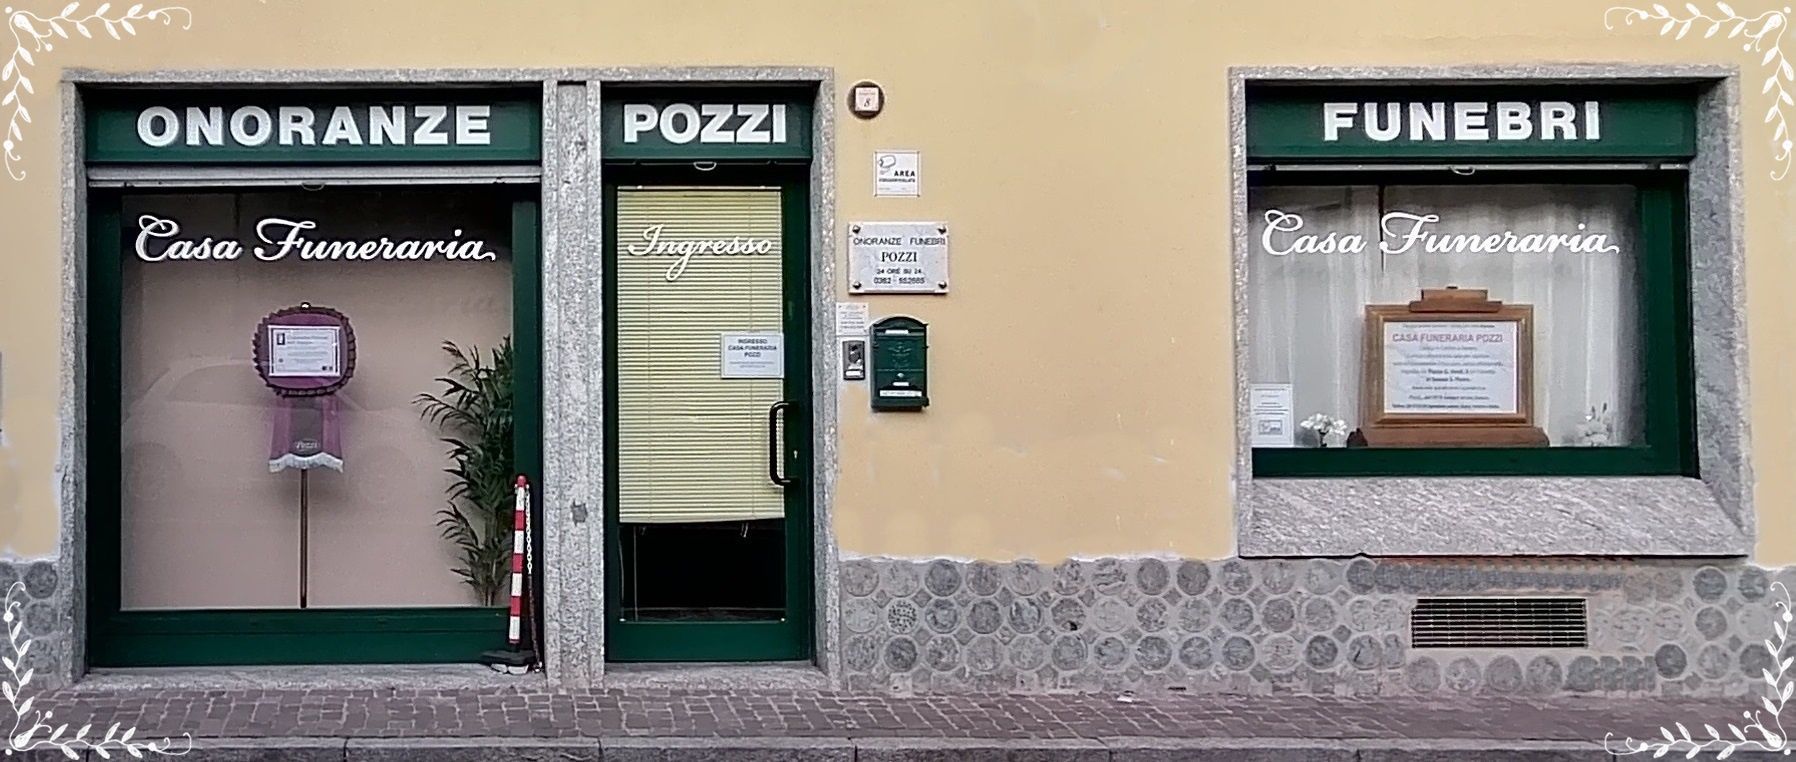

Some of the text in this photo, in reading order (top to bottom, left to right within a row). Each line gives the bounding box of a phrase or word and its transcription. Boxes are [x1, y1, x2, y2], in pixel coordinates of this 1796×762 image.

[136, 105, 491, 147] ONORANZE
[623, 103, 787, 144] POZZI
[1323, 101, 1600, 141] FUNEBRI
[135, 214, 496, 262] Casa Funeraria
[627, 224, 772, 281] Ingresso
[853, 237, 946, 246] ONORANZE FUNEBRI
[1262, 210, 1620, 255] Casa Funeraria
[881, 251, 917, 263] POZZI
[1392, 333, 1503, 343] CASA FUNERARIA POZZI
